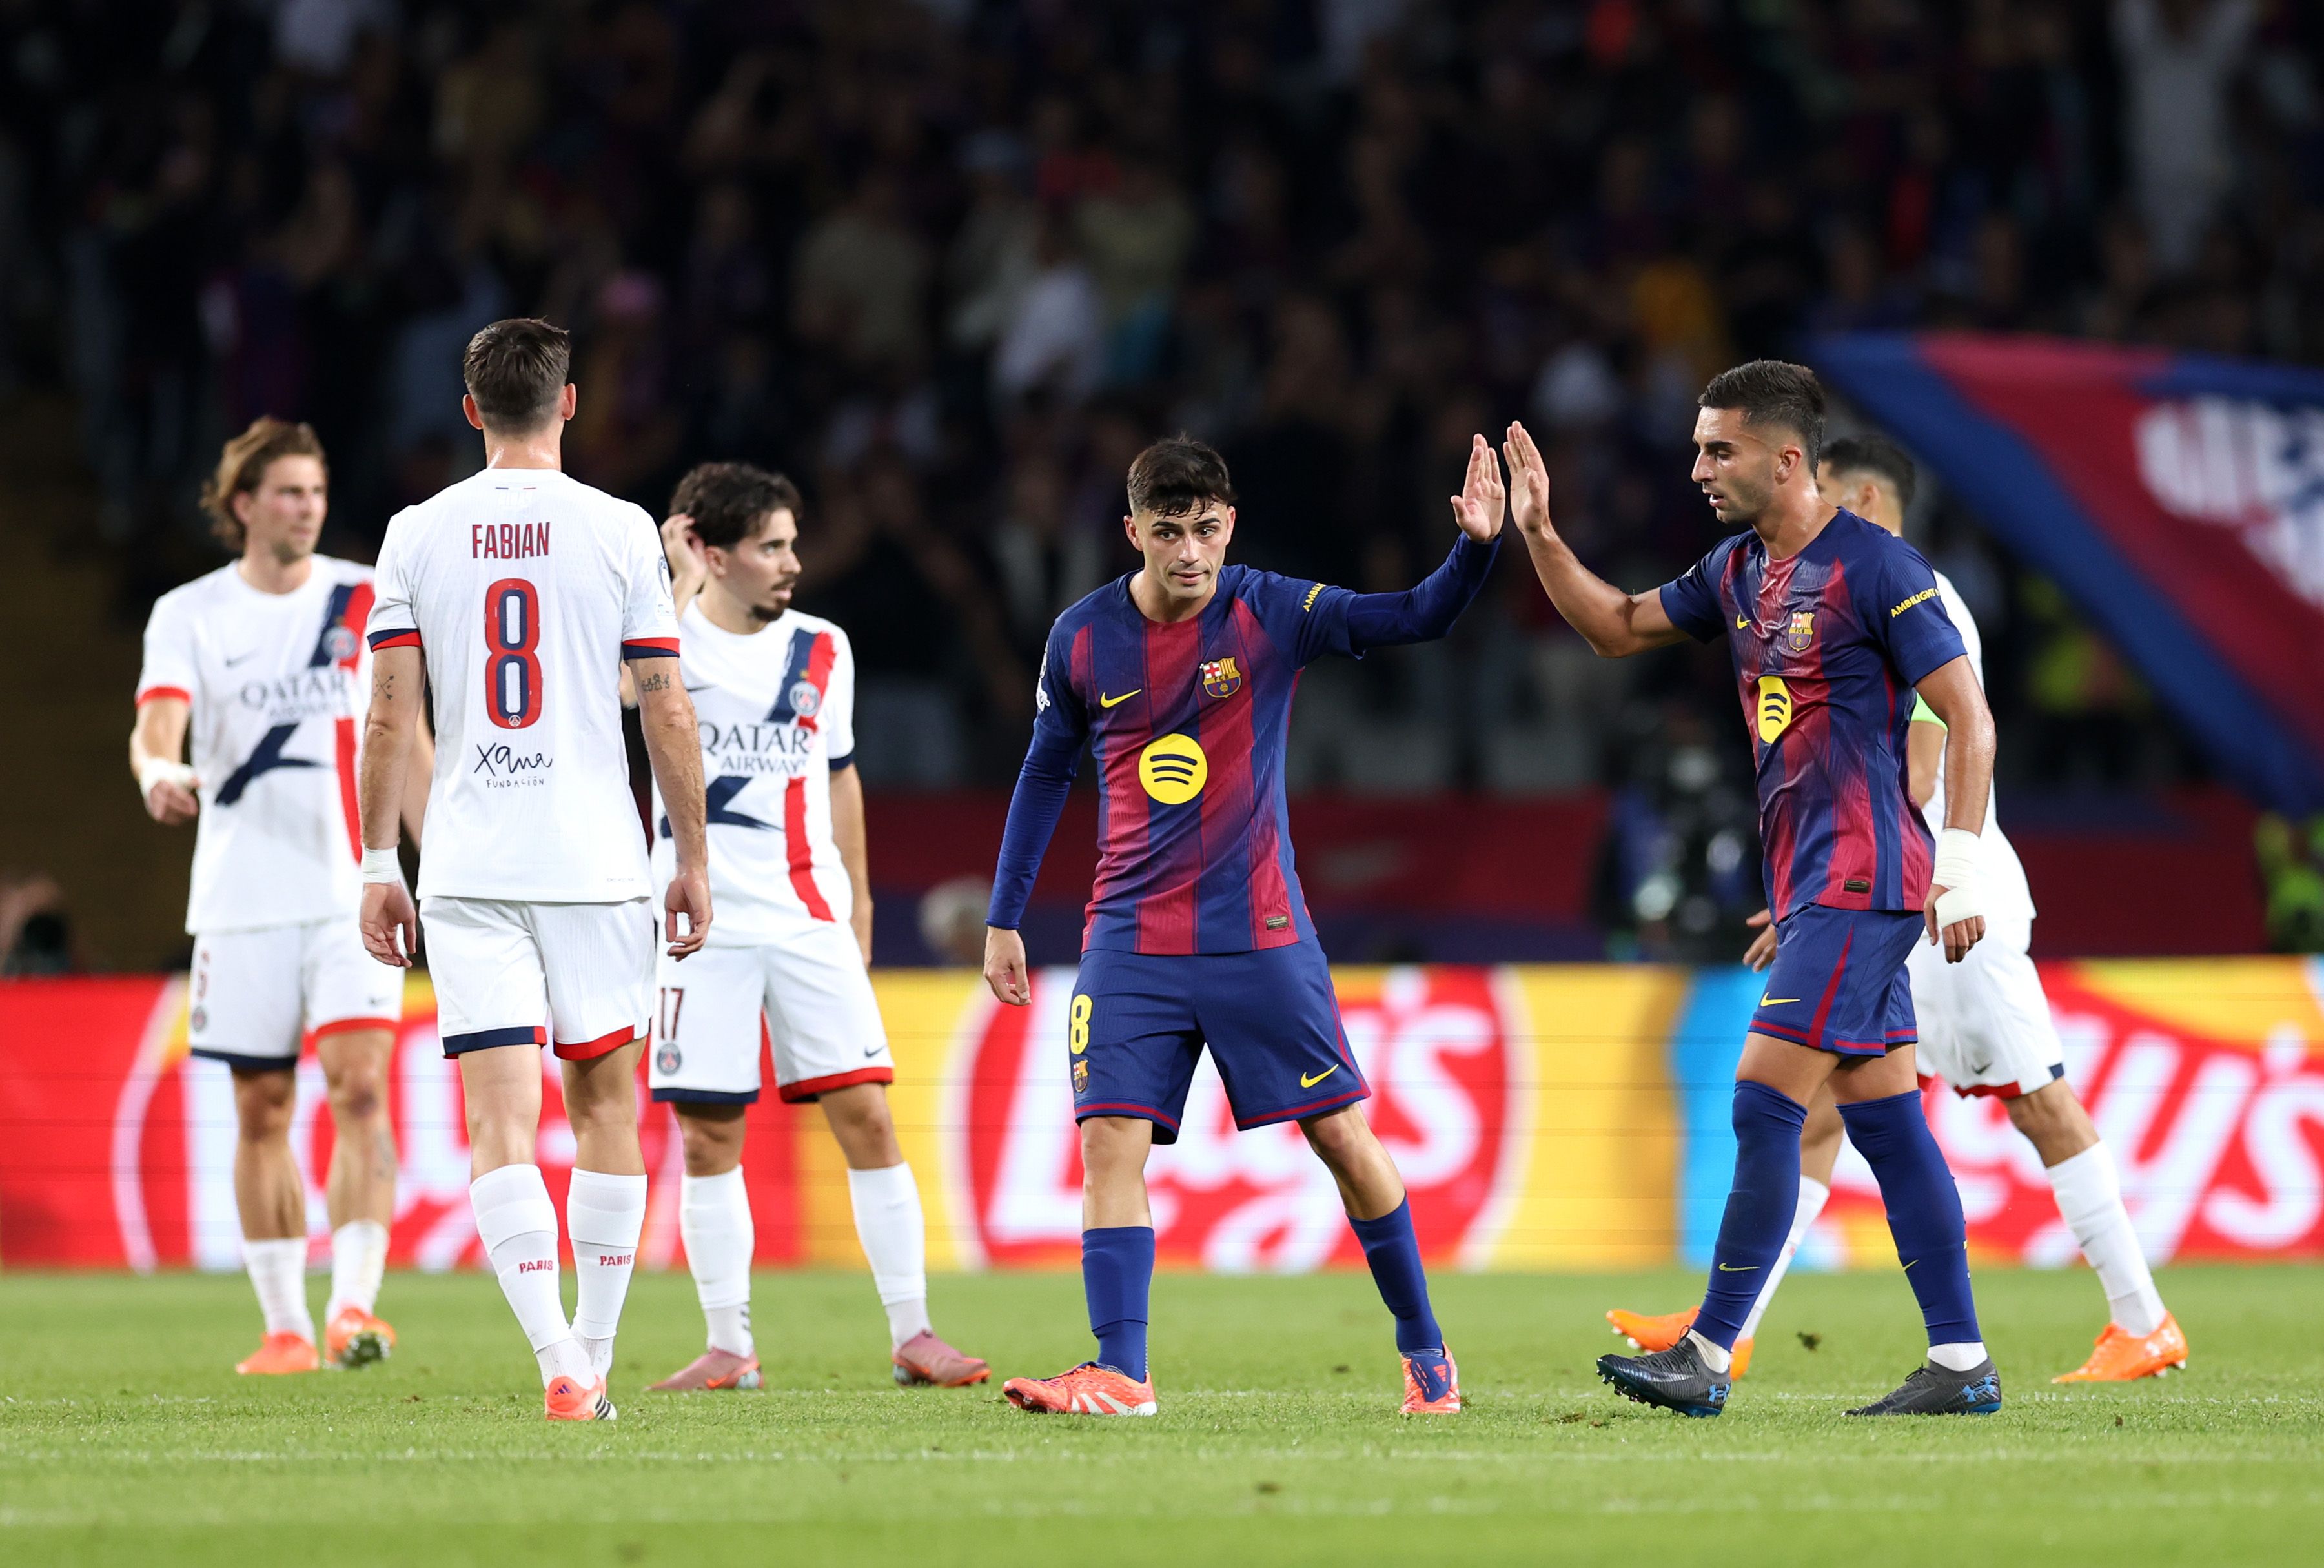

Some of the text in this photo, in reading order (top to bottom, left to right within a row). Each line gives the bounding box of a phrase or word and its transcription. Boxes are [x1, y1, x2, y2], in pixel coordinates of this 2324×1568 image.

[472, 522, 550, 559] FABIAN
[1891, 588, 1935, 618] AMBILIGHT
[485, 578, 543, 729] 8
[698, 720, 809, 756] QATAR
[660, 986, 684, 1040] 17
[1070, 993, 1093, 1055] 8
[519, 1260, 553, 1274] PARIS
[599, 1254, 632, 1267] PARIS
